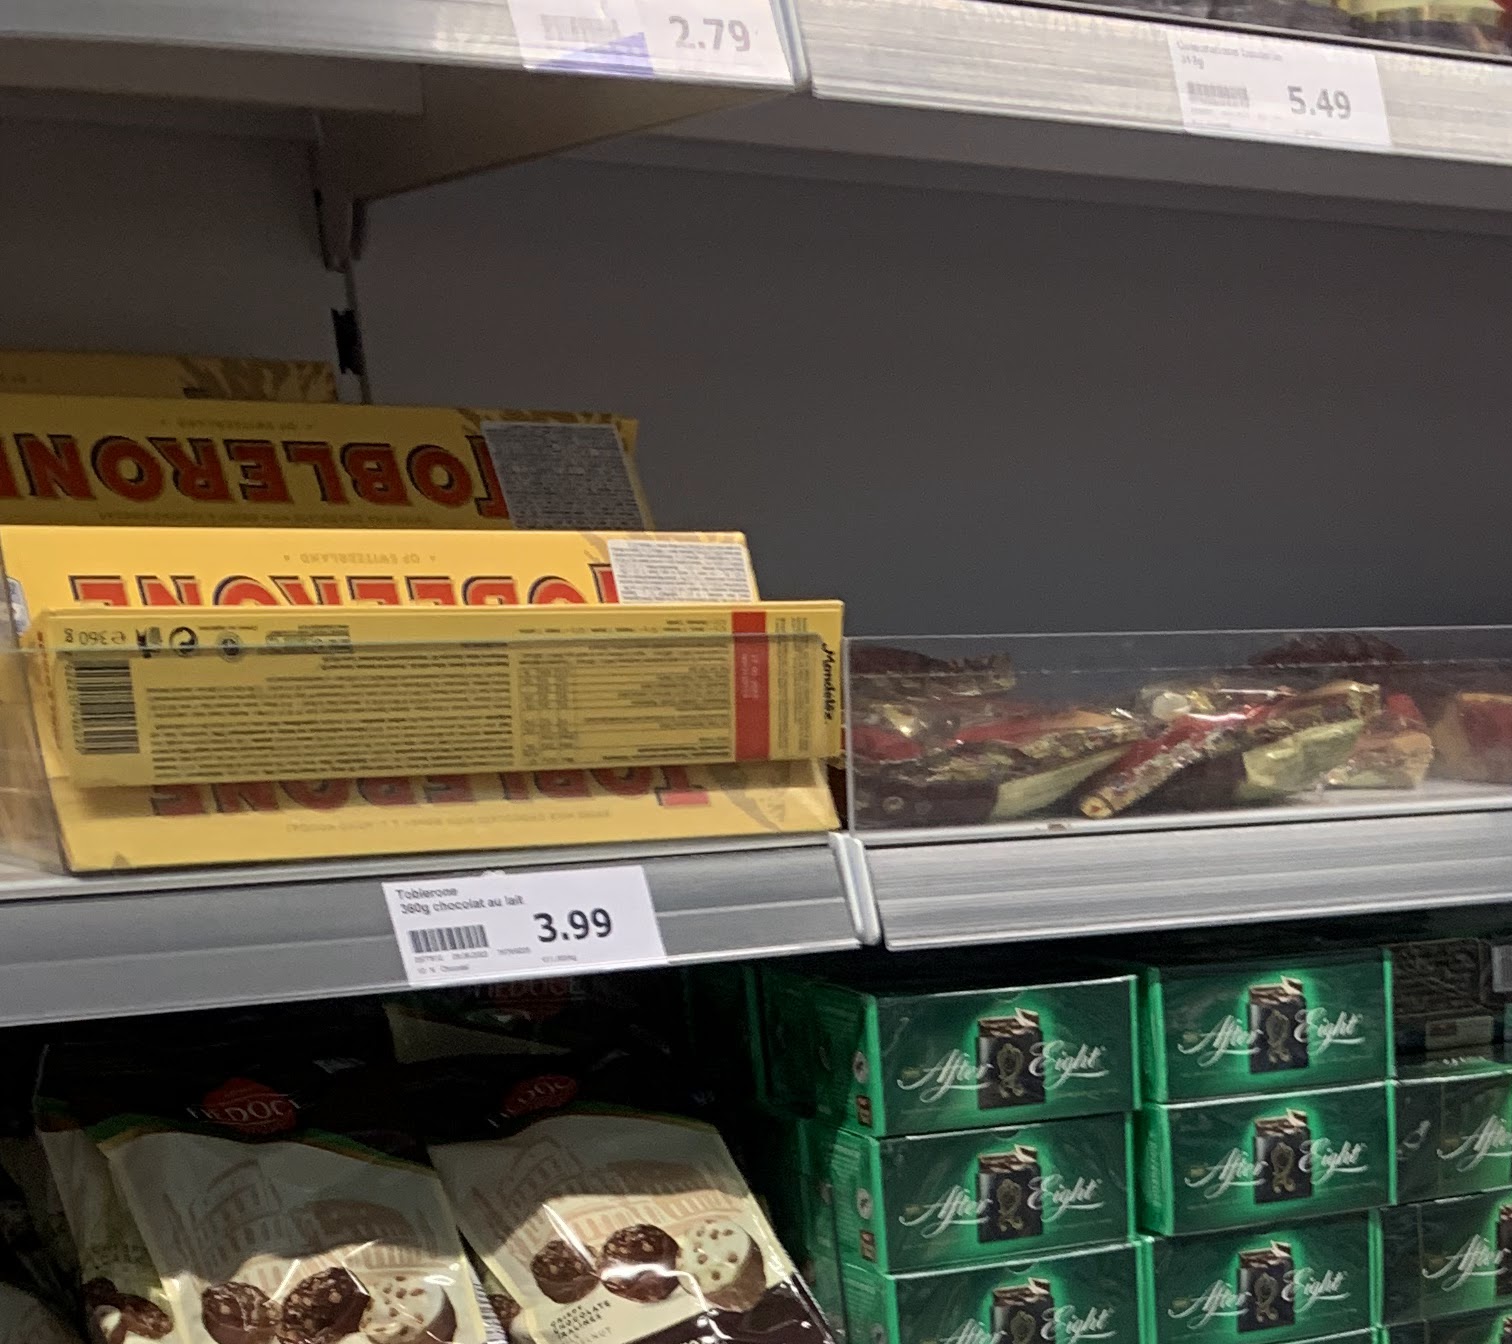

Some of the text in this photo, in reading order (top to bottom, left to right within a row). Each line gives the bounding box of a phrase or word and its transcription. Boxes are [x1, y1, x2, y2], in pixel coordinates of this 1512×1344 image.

[667, 15, 751, 51] 2.79
[1287, 85, 1352, 120] 5.49
[433, 898, 485, 912] chocolat
[534, 908, 613, 943] 3.99
